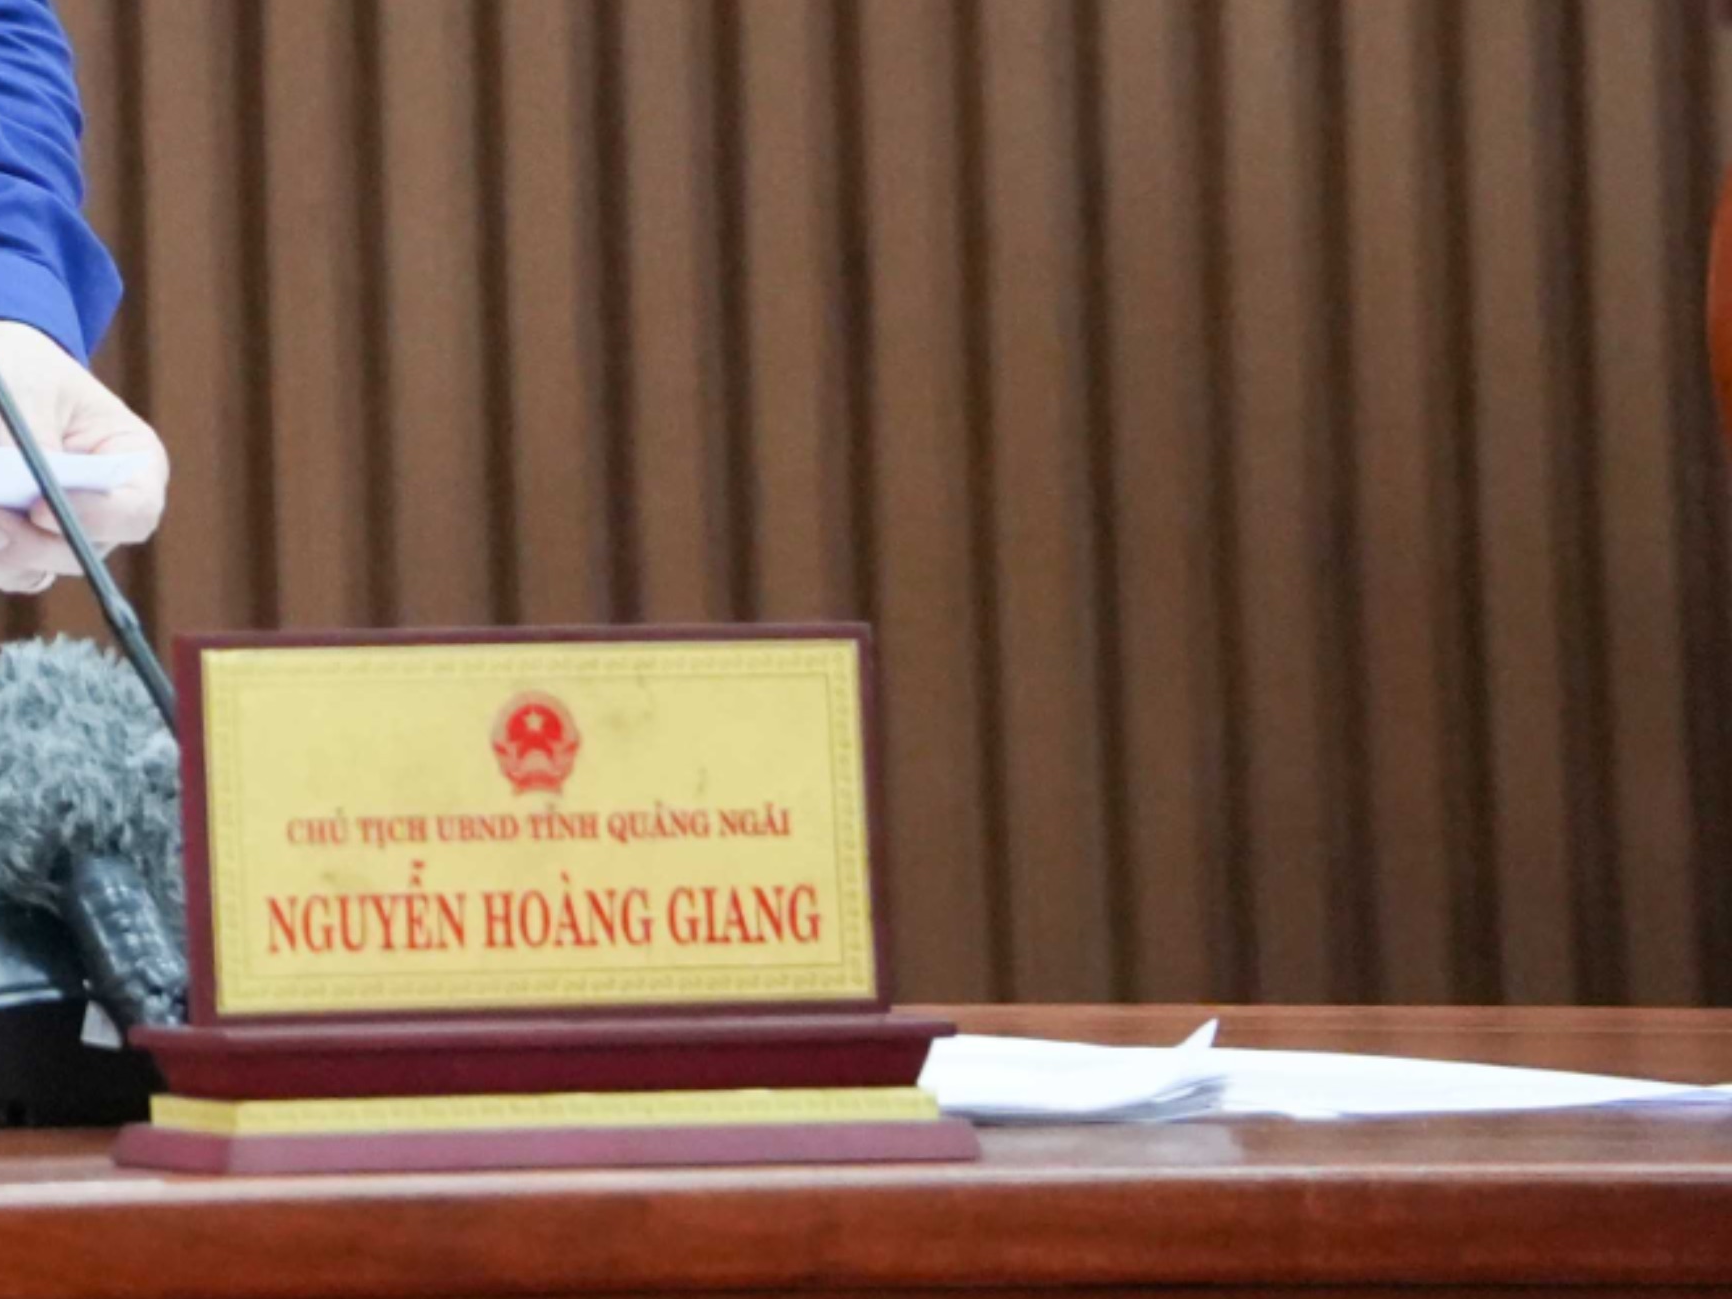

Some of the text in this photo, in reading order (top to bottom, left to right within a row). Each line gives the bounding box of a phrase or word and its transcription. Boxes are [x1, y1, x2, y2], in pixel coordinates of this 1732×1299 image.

[287, 800, 791, 850] CHỦ TỊCH UBND TỈNH QUẢNG NGÃI
[266, 859, 822, 955] NGUYỄN HOÀNG GIANG
